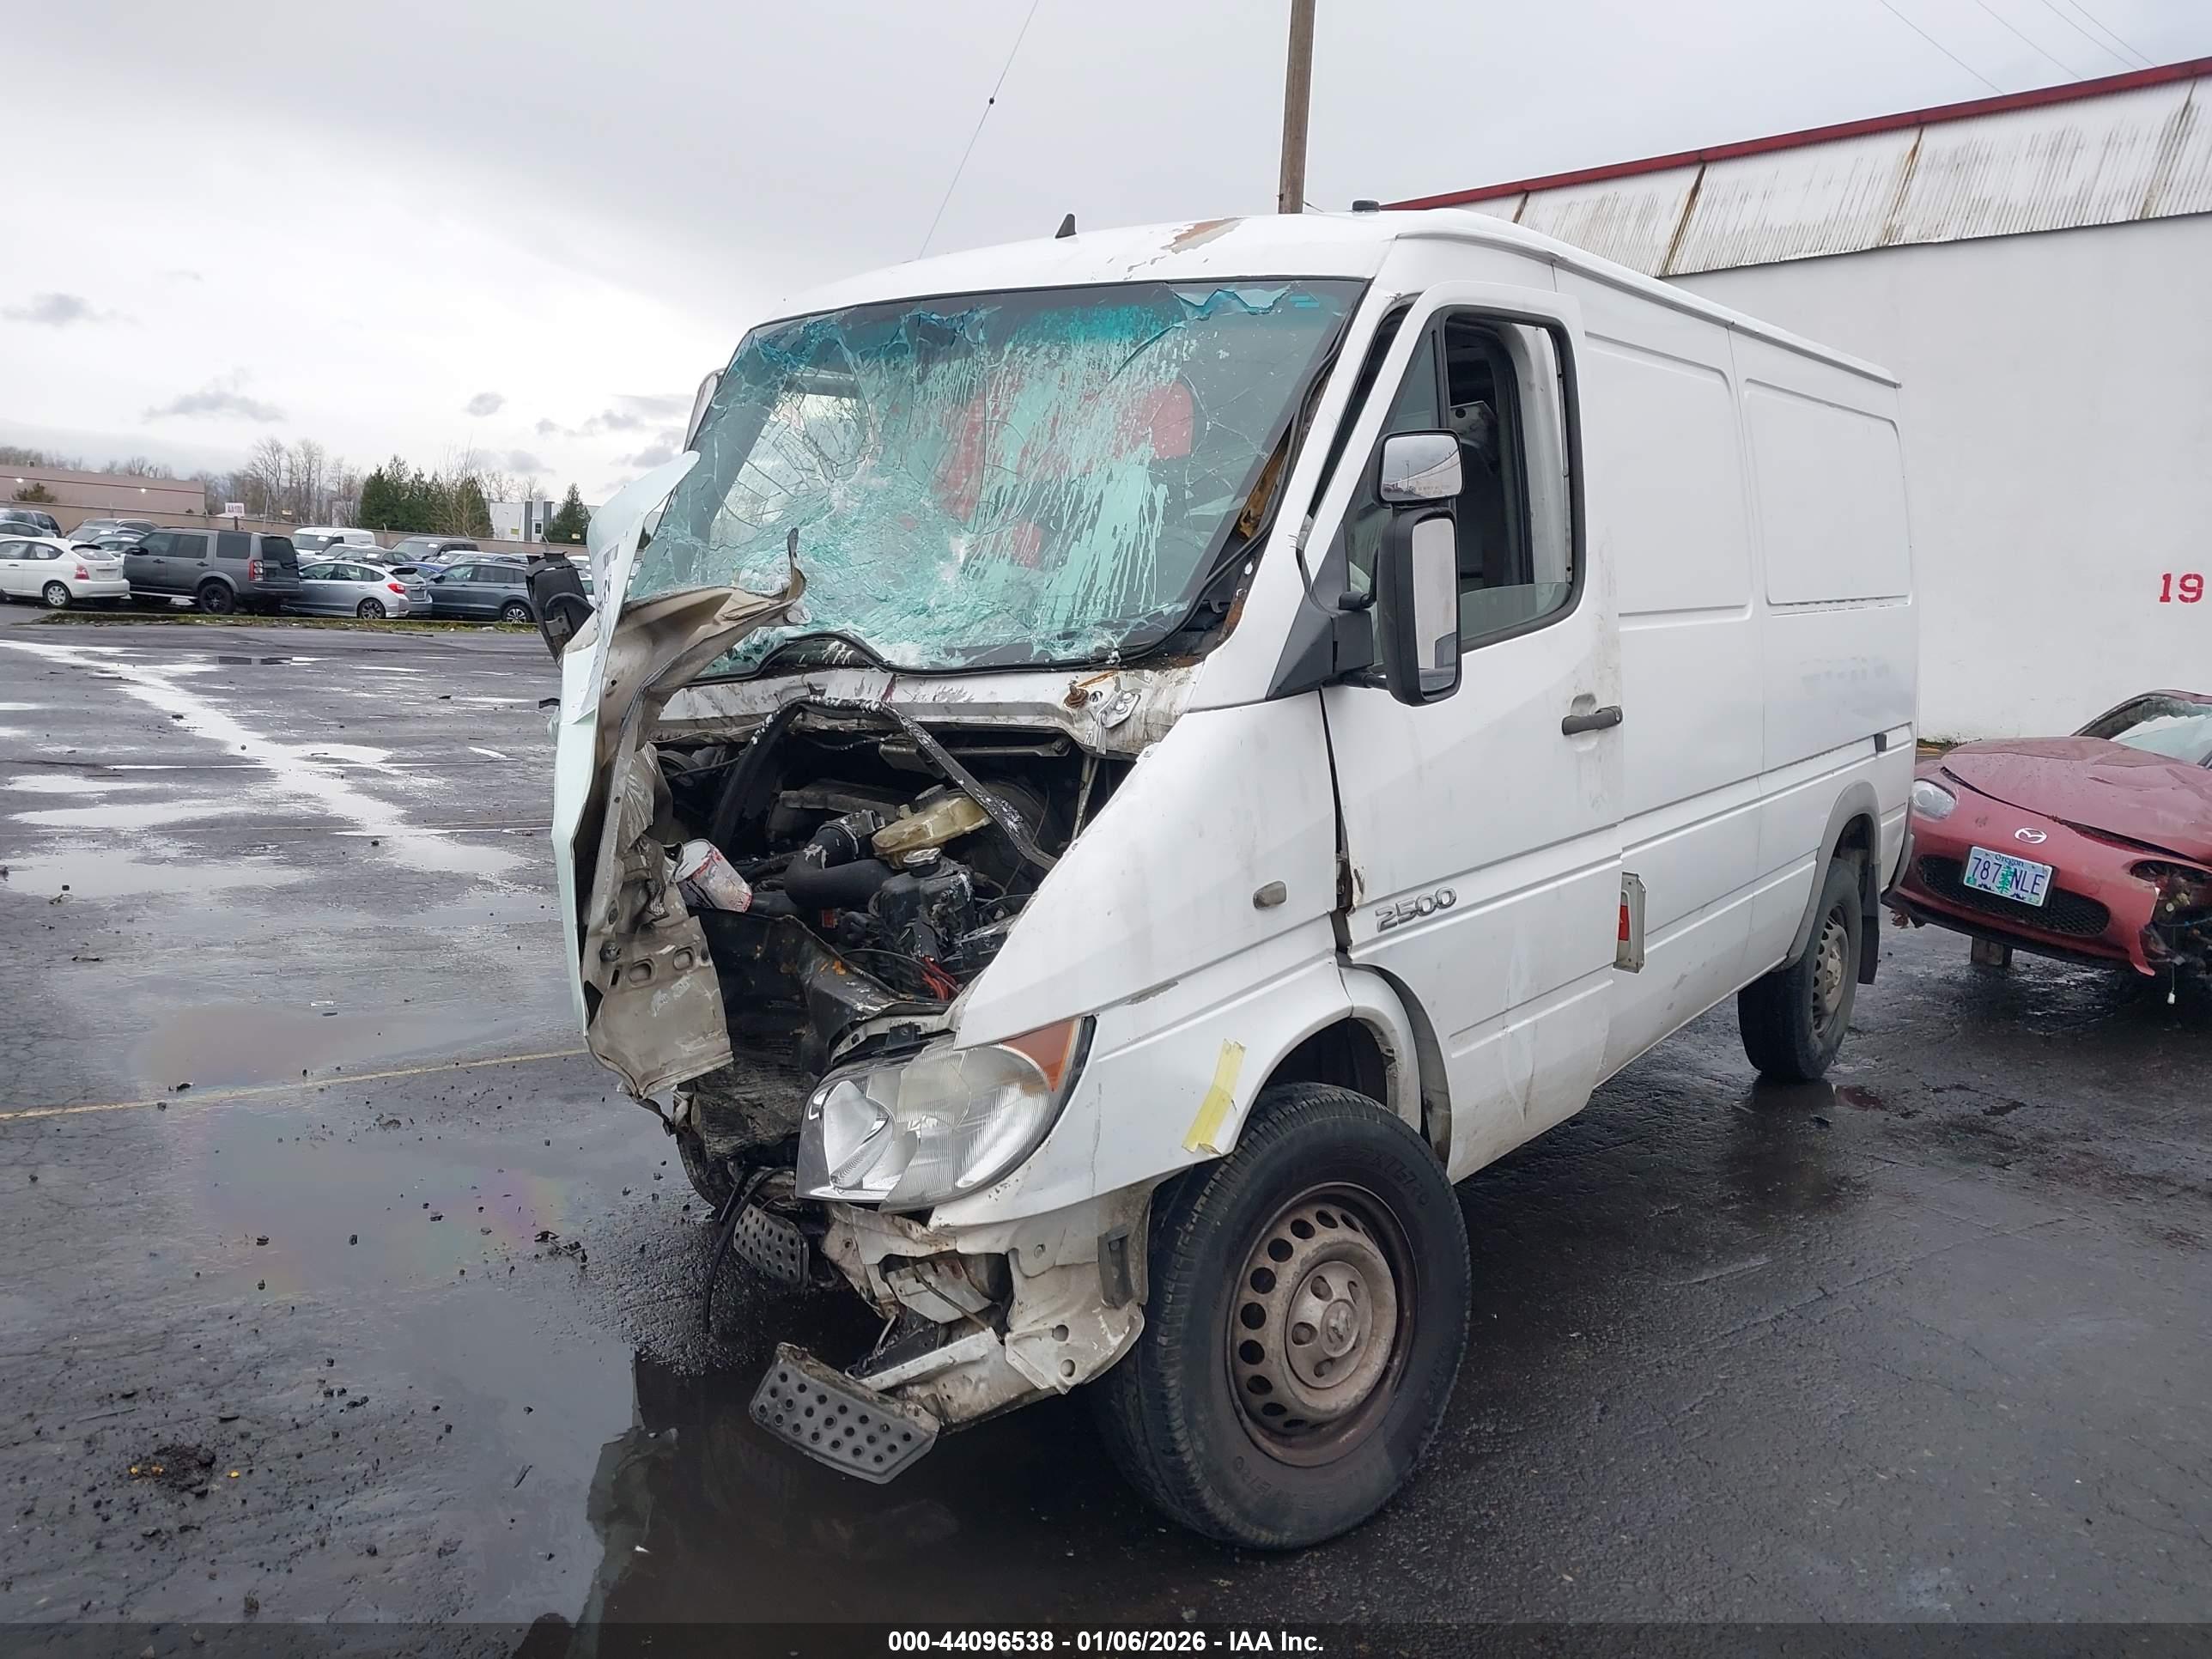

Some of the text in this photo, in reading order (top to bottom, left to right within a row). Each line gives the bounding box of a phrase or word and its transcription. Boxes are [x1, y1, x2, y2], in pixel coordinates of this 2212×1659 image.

[2159, 573, 2204, 604] 19
[1972, 856, 2045, 896] 787 NLE
[1995, 854, 2024, 867] Oregon
[1375, 886, 1457, 933] 2500
